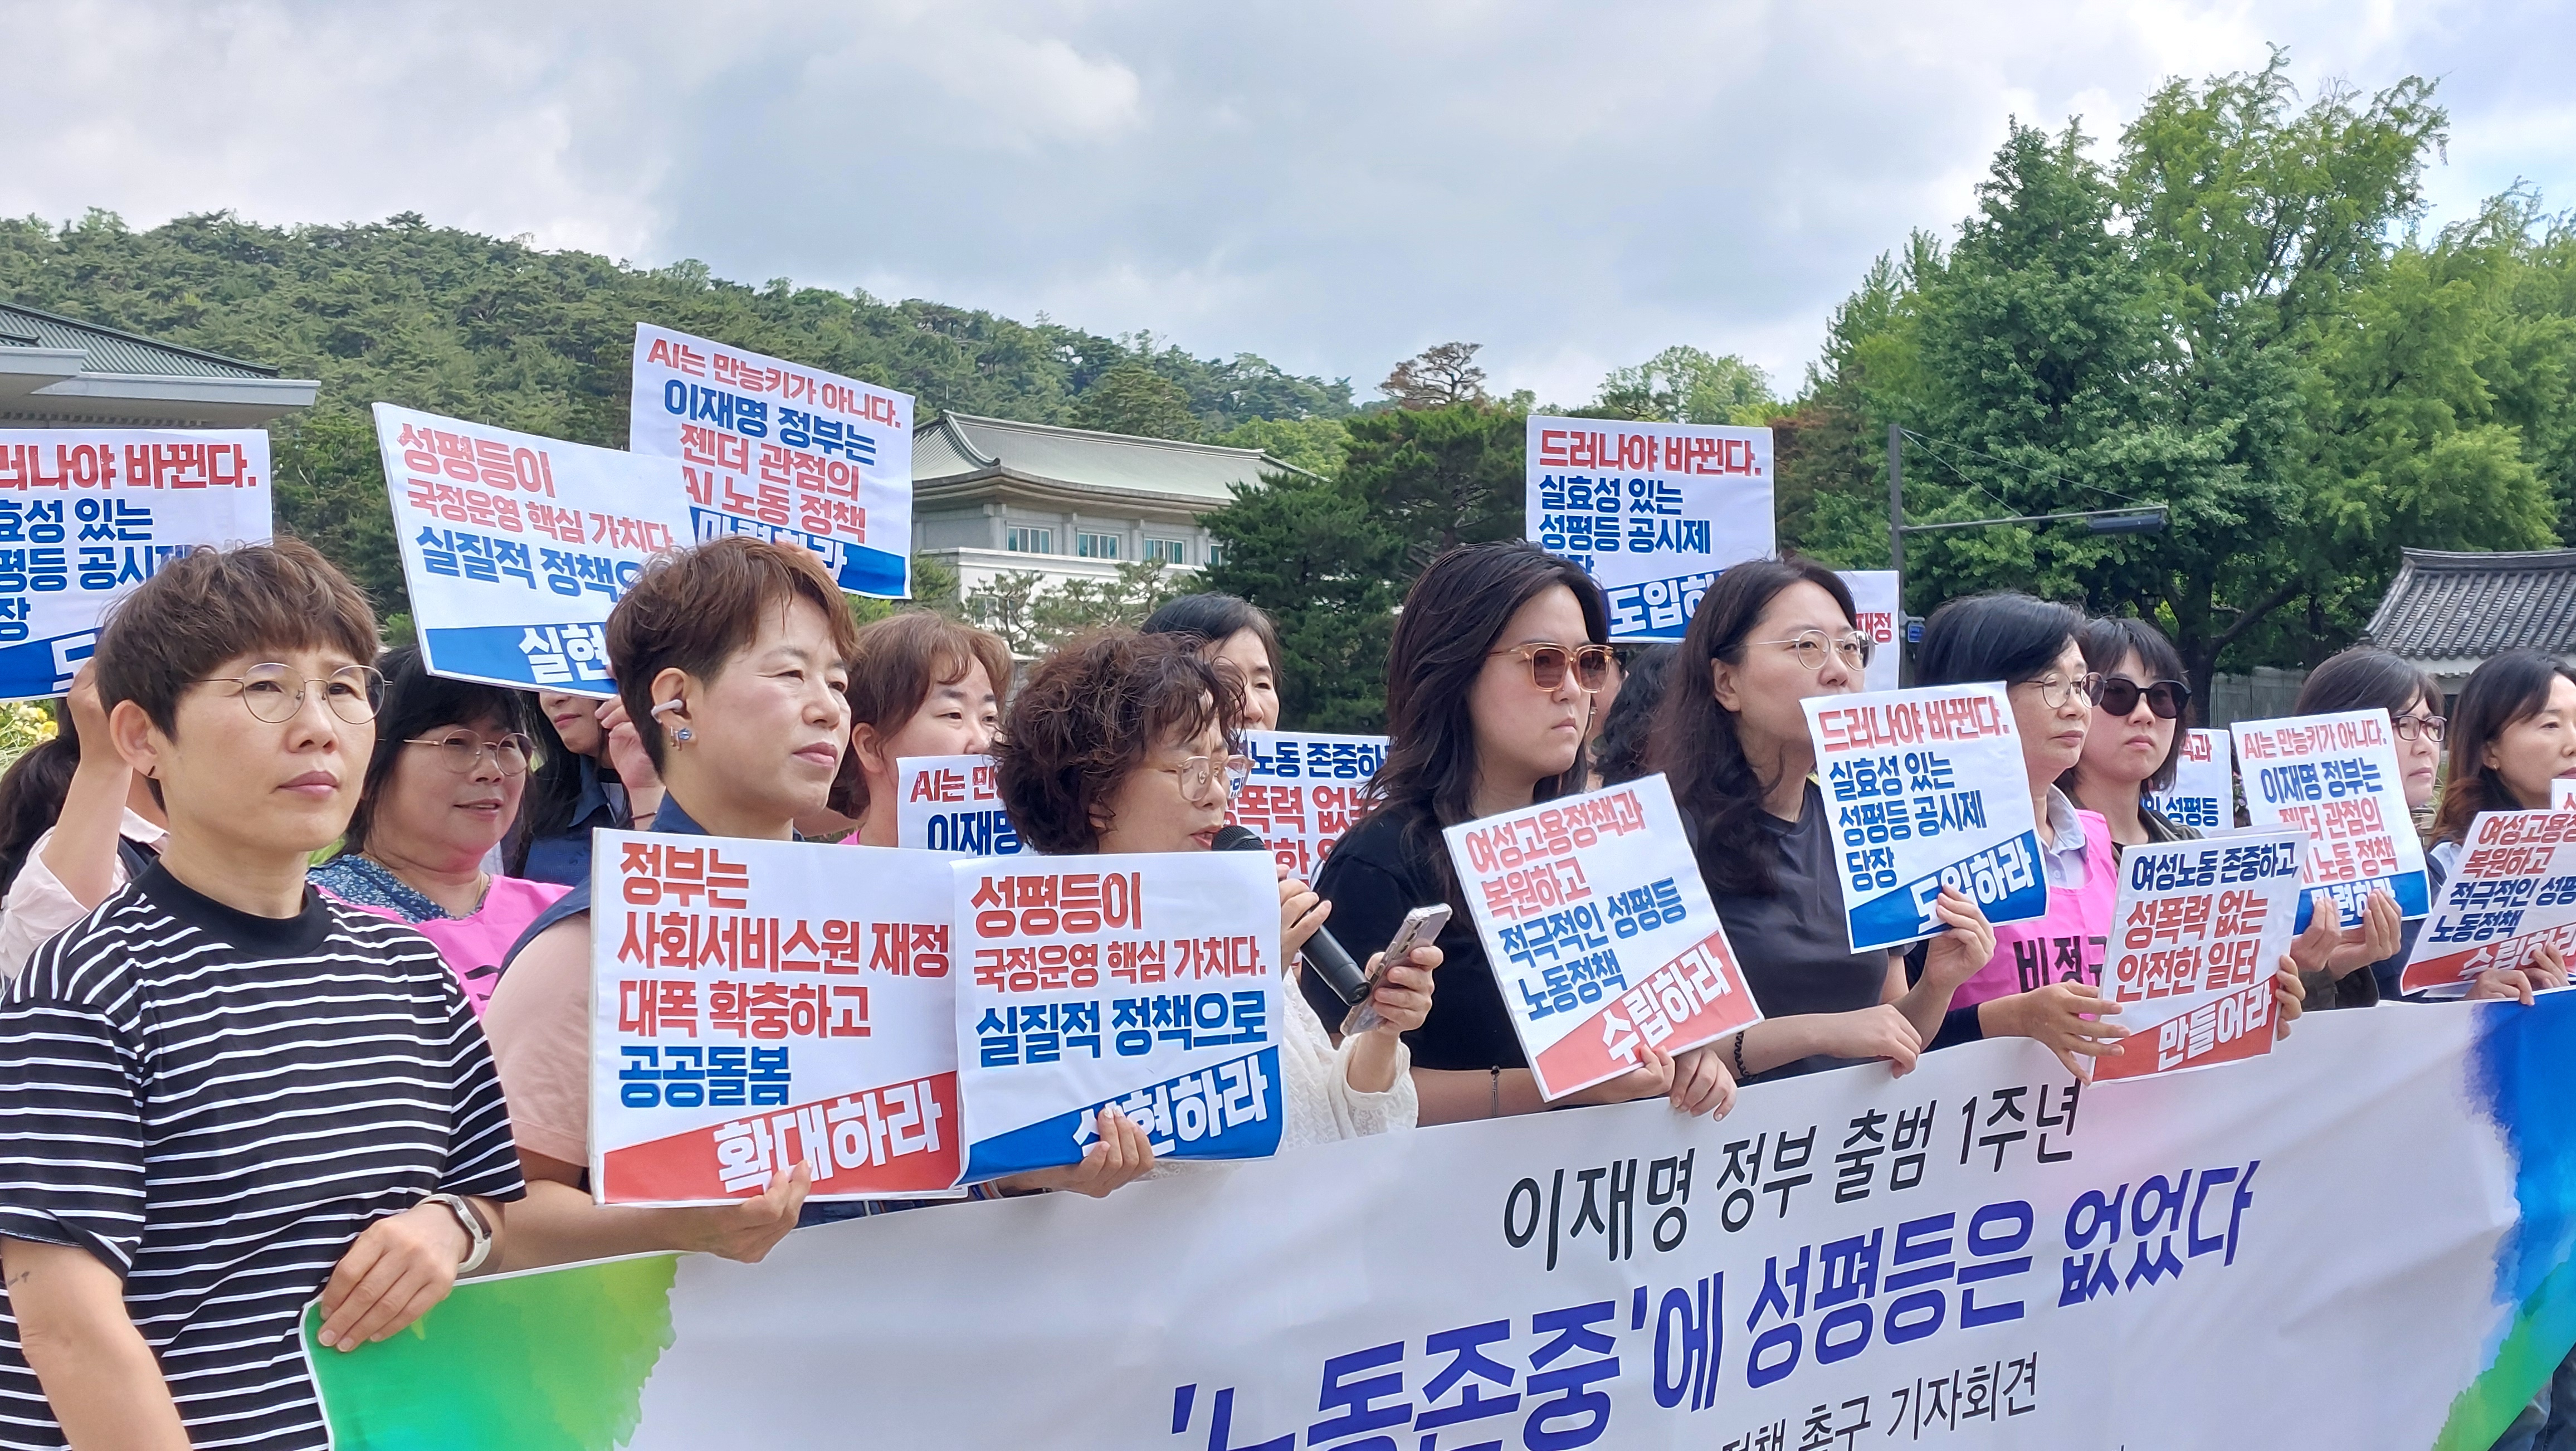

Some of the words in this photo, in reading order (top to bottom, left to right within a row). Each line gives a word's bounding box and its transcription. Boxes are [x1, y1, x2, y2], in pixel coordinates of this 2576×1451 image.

[647, 339, 705, 377] AI는
[713, 353, 817, 405] 만능키가
[822, 383, 901, 429] 아니다.
[665, 379, 768, 438] 이재명
[779, 406, 876, 466] 정부는
[1540, 430, 1658, 471] 드러나야
[1665, 437, 1762, 476] 바뀐다.
[125, 444, 257, 489] 바뀐다.
[397, 423, 555, 498] 성평등이
[680, 423, 749, 475] 젠더
[759, 444, 859, 501] 관점의
[75, 498, 153, 542] 있는
[407, 478, 524, 533] 국정운영
[526, 502, 585, 544] 핵심
[683, 465, 713, 507] AI
[721, 476, 790, 525] 노동
[799, 495, 866, 544] 정책
[1539, 475, 1621, 513] 실효성
[1628, 478, 1684, 515] 있는
[416, 526, 537, 590] 실질적
[1539, 514, 1621, 552] 성평등
[1628, 517, 1710, 554] 공시제
[1818, 702, 1924, 752] 드러나야
[1925, 696, 2010, 741] 바뀐다.
[2245, 731, 2277, 759] AI는
[2276, 724, 2337, 754] 만능키가
[2338, 719, 2387, 749] 아니다.
[910, 768, 965, 803] AI는
[1829, 755, 1902, 801] 실효성
[1905, 751, 1954, 792] 있는
[2261, 762, 2322, 804] 이재명
[2323, 757, 2384, 798] 정부는
[1466, 788, 1646, 874] 여성고용정책과
[1839, 800, 1911, 847] 성평등
[1914, 790, 1987, 837] 공시제
[2165, 797, 2219, 827] 성평등
[2322, 796, 2385, 839] 관점의
[620, 841, 749, 909] 정부는
[1481, 856, 1592, 921] 복원하고
[1846, 846, 1897, 892] 당장
[2131, 850, 2218, 892] 여성노동
[2221, 842, 2299, 885] 존중하고,
[2314, 842, 2356, 882] 노동
[2355, 835, 2399, 876] 정책
[2462, 847, 2555, 879] 복원하고
[970, 871, 1142, 938] 성평등이
[1499, 902, 1609, 968] 적극적인
[1607, 877, 1686, 939] 성평등
[2125, 894, 2212, 950] 성폭력
[2214, 889, 2268, 938] 없는
[2428, 909, 2525, 943] 노동정책
[2450, 878, 2540, 912] 적극적인
[617, 912, 860, 975] 사회서비스원
[868, 923, 949, 978] 재정
[973, 943, 1099, 993] 국정운영
[1107, 941, 1166, 985] 핵심
[1173, 935, 1266, 980] 가치다.
[2116, 947, 2202, 1002] 안전한
[2206, 939, 2260, 990] 일터
[618, 980, 698, 1038] 대폭
[709, 980, 871, 1039] 확충하고
[1518, 948, 1627, 1021] 노동정책
[1602, 943, 1732, 1064] 수립하라
[975, 1001, 1101, 1068] 실질적
[1111, 990, 1269, 1056] 정책으로
[2158, 978, 2272, 1071] 만들어라
[618, 1045, 791, 1108] 공공돌봄
[714, 1079, 943, 1193] 확대하라
[1503, 1147, 1695, 1271] 이재명
[1716, 1125, 1817, 1233] 정부
[1833, 1100, 1936, 1204] 출범
[1959, 1078, 2081, 1172] 1주년
[1746, 1199, 2033, 1388] 성평등은
[2057, 1160, 2260, 1308] 없었다
[1887, 1351, 2038, 1439] 기자회견
